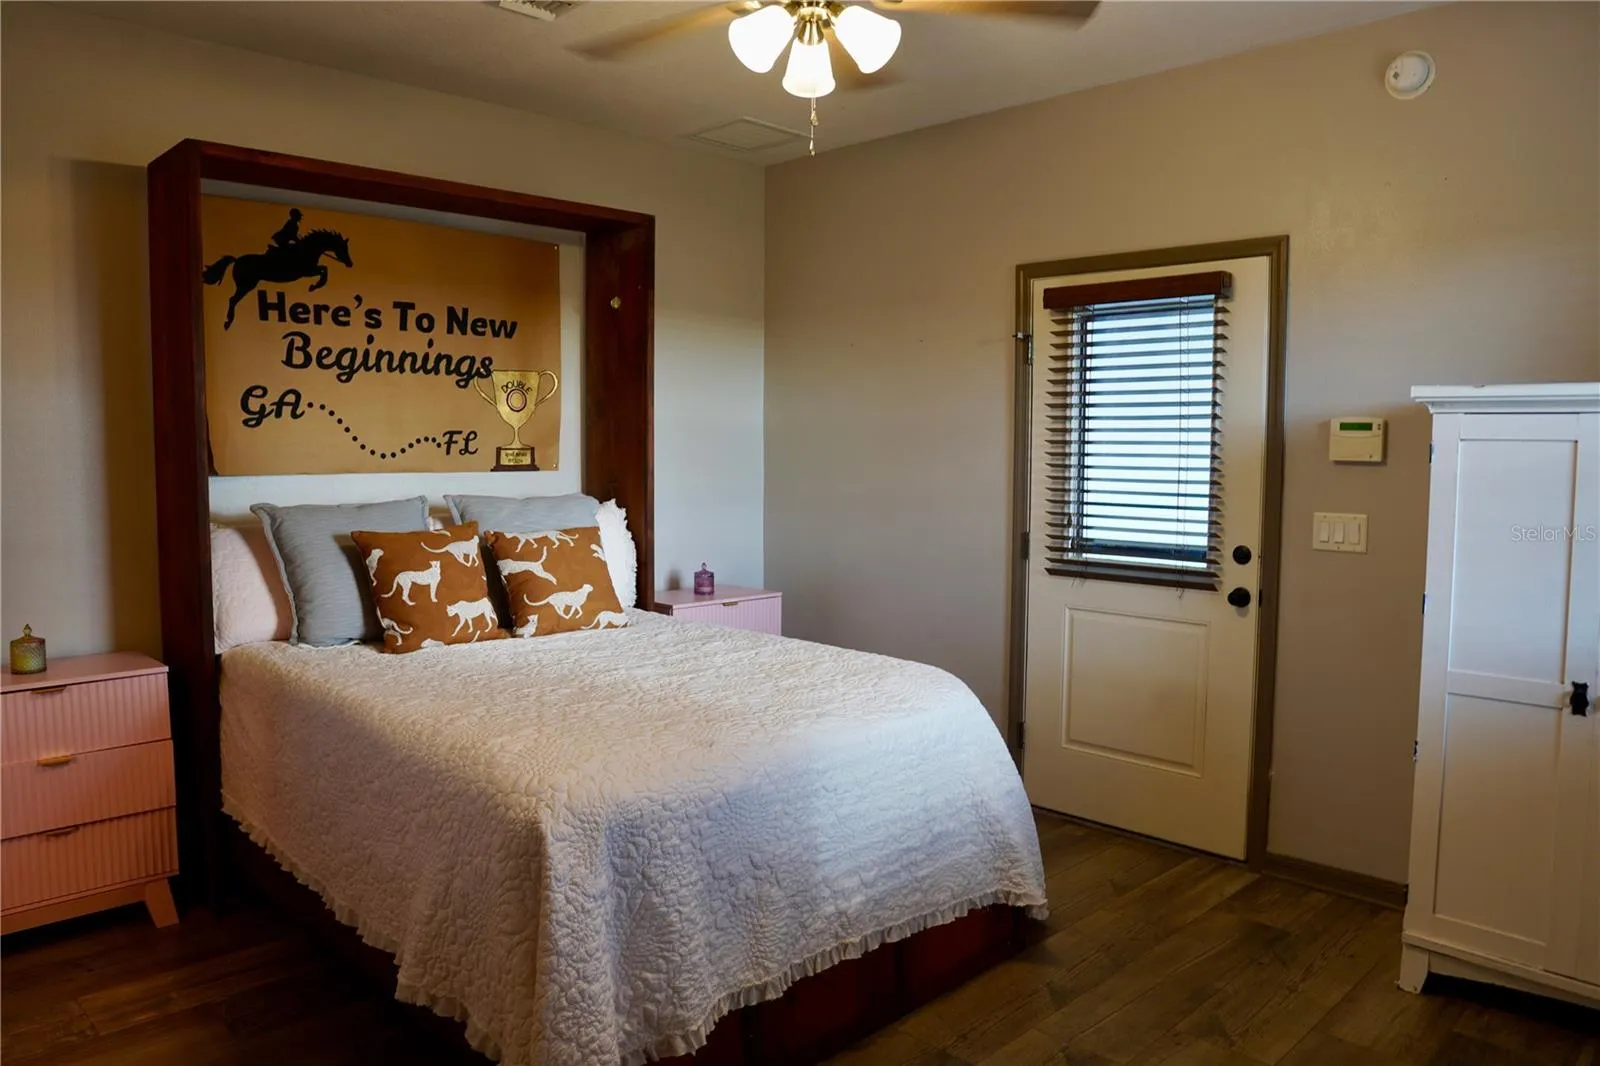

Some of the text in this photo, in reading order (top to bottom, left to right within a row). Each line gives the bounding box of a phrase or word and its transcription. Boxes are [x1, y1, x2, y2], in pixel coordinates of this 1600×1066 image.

[257, 289, 518, 339] Here's To New
[281, 331, 494, 389] Beginnings
[240, 384, 306, 428] GA
[501, 379, 533, 395] DOUBLE
[442, 430, 478, 455] FL
